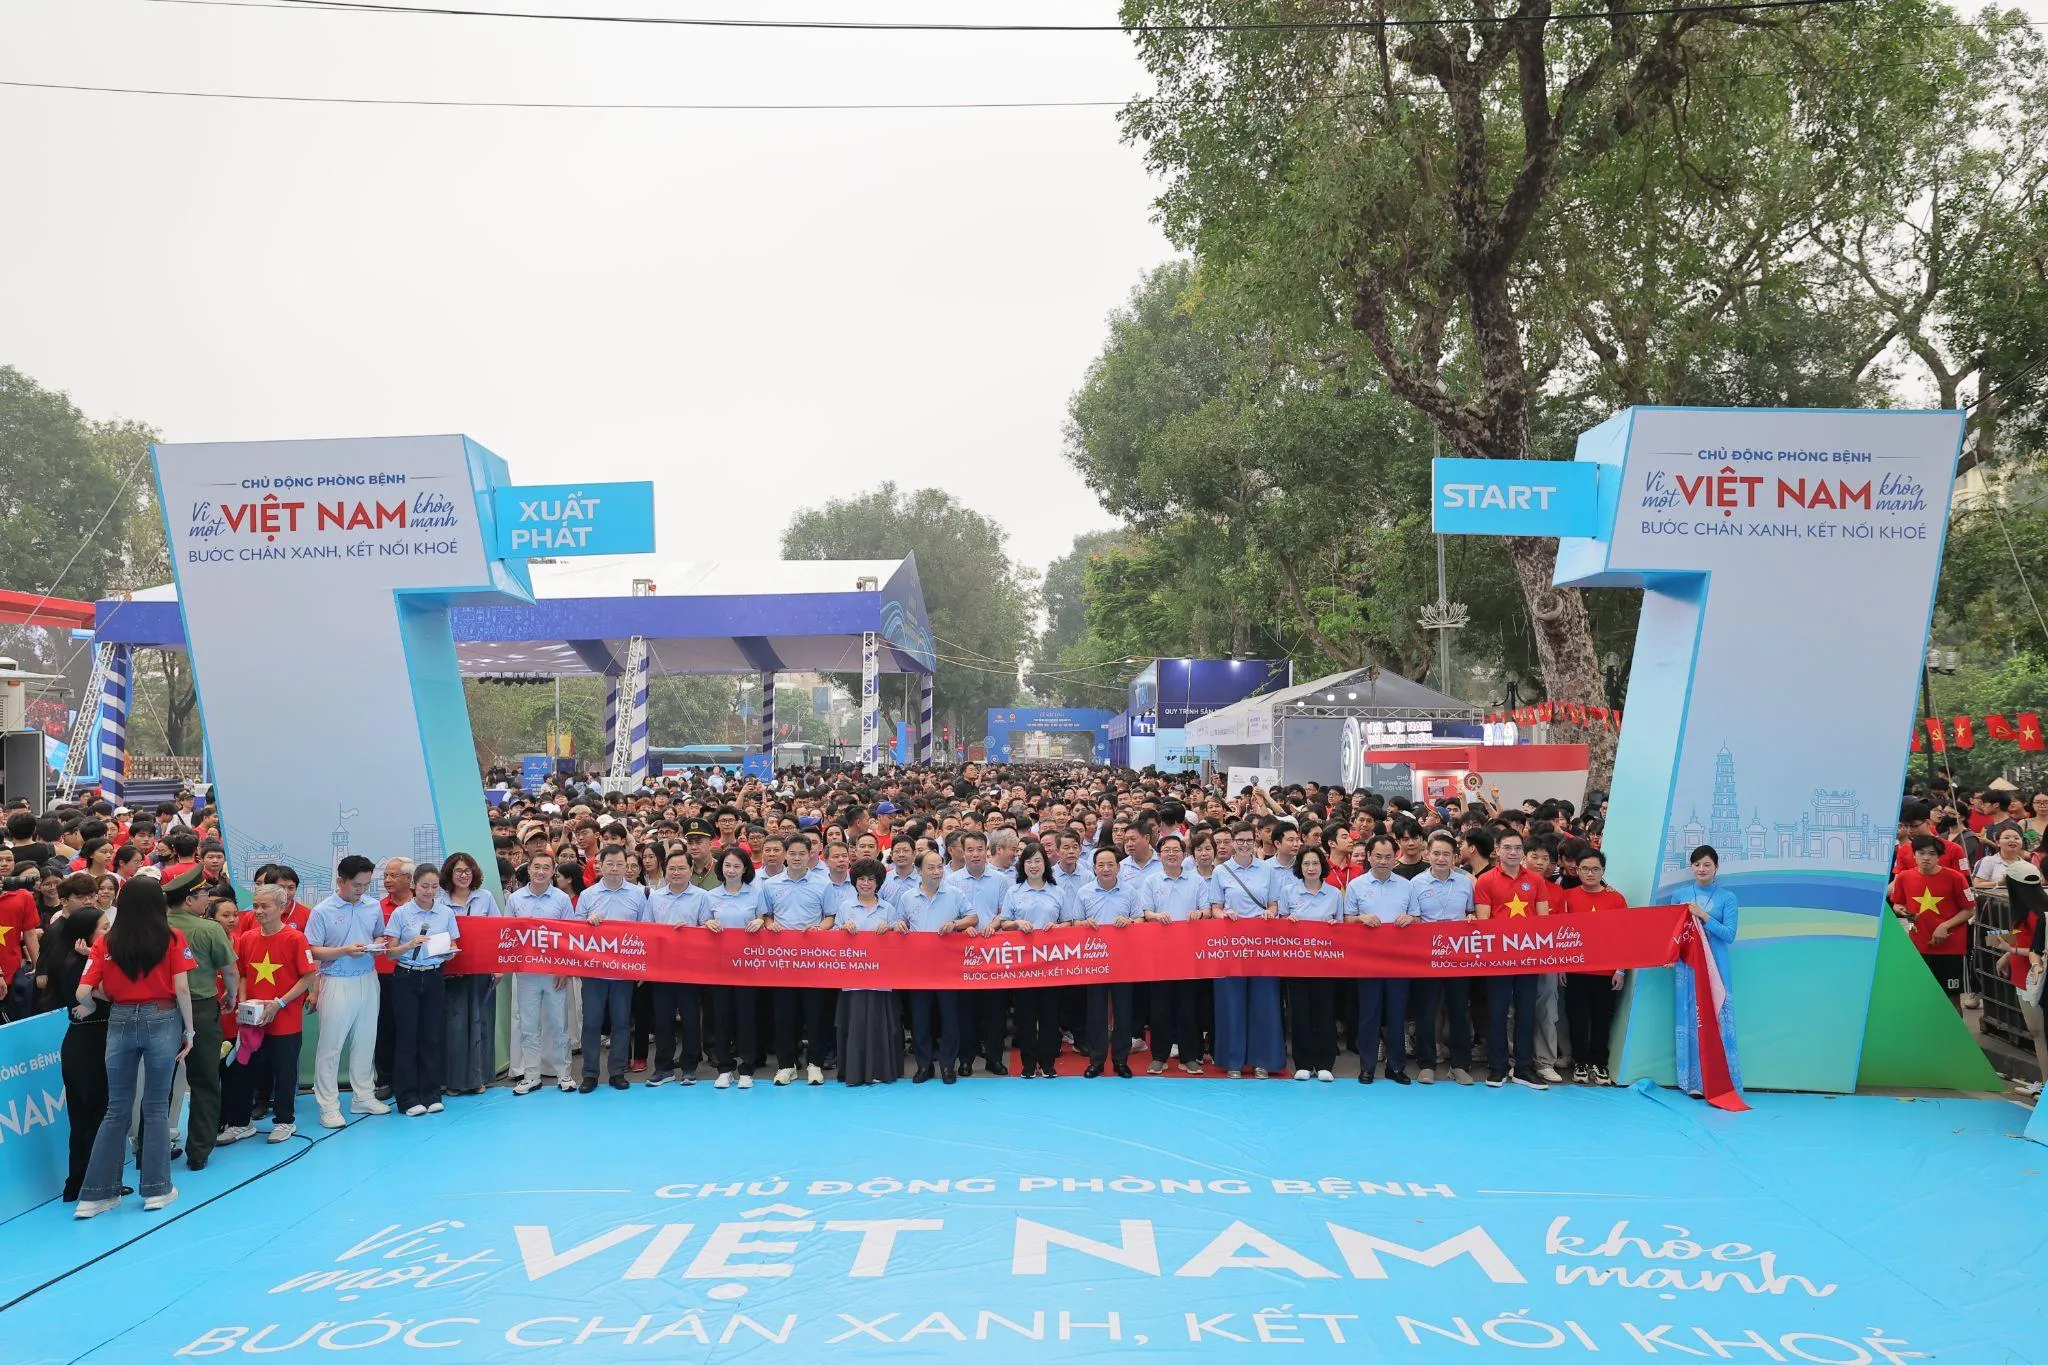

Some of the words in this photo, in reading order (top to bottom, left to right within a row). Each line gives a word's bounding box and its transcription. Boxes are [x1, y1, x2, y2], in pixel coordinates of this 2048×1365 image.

[1698, 450, 1727, 460] CHỦ
[1731, 449, 1773, 464] ĐỘNG
[1778, 451, 1828, 462] PHÒNG
[1833, 453, 1871, 464] BỆNH
[242, 476, 269, 488] CHỦ
[274, 476, 313, 490] ĐỘNG
[318, 474, 365, 486] PHÒNG
[369, 473, 405, 486] BỆNH
[1676, 465, 1764, 517] VIỆT
[1777, 477, 1871, 509] NAM
[519, 490, 601, 522] XUẤT
[1443, 484, 1557, 510] START
[221, 493, 305, 542] VIỆT
[317, 499, 406, 531] NAM
[511, 521, 592, 551] PHÁT
[1641, 520, 1688, 535] BƯỚC
[1694, 521, 1742, 536] CHÂN
[1748, 524, 1802, 539] XANH,
[1807, 521, 1837, 538] KẾT
[1842, 523, 1873, 538] NỐI
[189, 546, 234, 562] BƯỚC
[240, 544, 285, 561] CHÂN
[291, 544, 341, 560] XANH,
[347, 540, 374, 557] KẾT
[380, 539, 408, 556] NỐI
[516, 925, 563, 953] VIỆT
[569, 933, 618, 953] NAM
[1207, 936, 1228, 946] CHỦ
[1231, 936, 1261, 947] ĐỘNG
[1265, 936, 1300, 945] PHÒNG
[1450, 930, 1495, 958] VIỆT
[1503, 933, 1554, 951] NAM
[498, 955, 522, 963] BƯỚC
[525, 955, 552, 964] CHÂN
[554, 957, 581, 967] XANH,
[584, 957, 600, 968] KẾT
[603, 958, 619, 969] NỐI
[744, 946, 764, 955] CHỦ
[768, 947, 797, 956] ĐỘNG
[801, 948, 836, 956] PHÒNG
[840, 948, 866, 959] BỆNH
[980, 941, 1025, 969] VIỆT
[1033, 943, 1081, 962] NAM
[1196, 950, 1204, 959] VÌ
[1208, 949, 1230, 958] MỘT
[1233, 948, 1254, 957] VIỆT
[1314, 951, 1344, 960] MẠNH
[1431, 959, 1457, 968] BƯỚC
[1459, 959, 1487, 968] CHÂN
[1521, 956, 1536, 966] KẾT
[1539, 955, 1556, 965] NỐI
[732, 958, 741, 966] VÌ
[745, 959, 766, 969] MỘT
[769, 959, 790, 969] VIỆT
[849, 962, 879, 971] MẠNH
[963, 972, 988, 981] BƯỚC
[991, 969, 1016, 979] CHÂN
[1049, 966, 1064, 976] KẾT
[1067, 965, 1083, 975] NỐI
[29, 1051, 61, 1072] BỆNH
[656, 1177, 789, 1198] CHỦ
[808, 1177, 995, 1197] ĐỘNG
[1019, 1176, 1250, 1193] PHÒNG
[1272, 1178, 1455, 1198] BỆNH
[514, 1204, 944, 1301] VIỆT
[1011, 1216, 1528, 1284] NAM
[174, 1310, 480, 1357] BƯỚC
[504, 1307, 799, 1349] CHÂN
[827, 1303, 1150, 1347] XANH,
[1186, 1301, 1359, 1347] KẾT
[1397, 1306, 1599, 1352] NỐI
